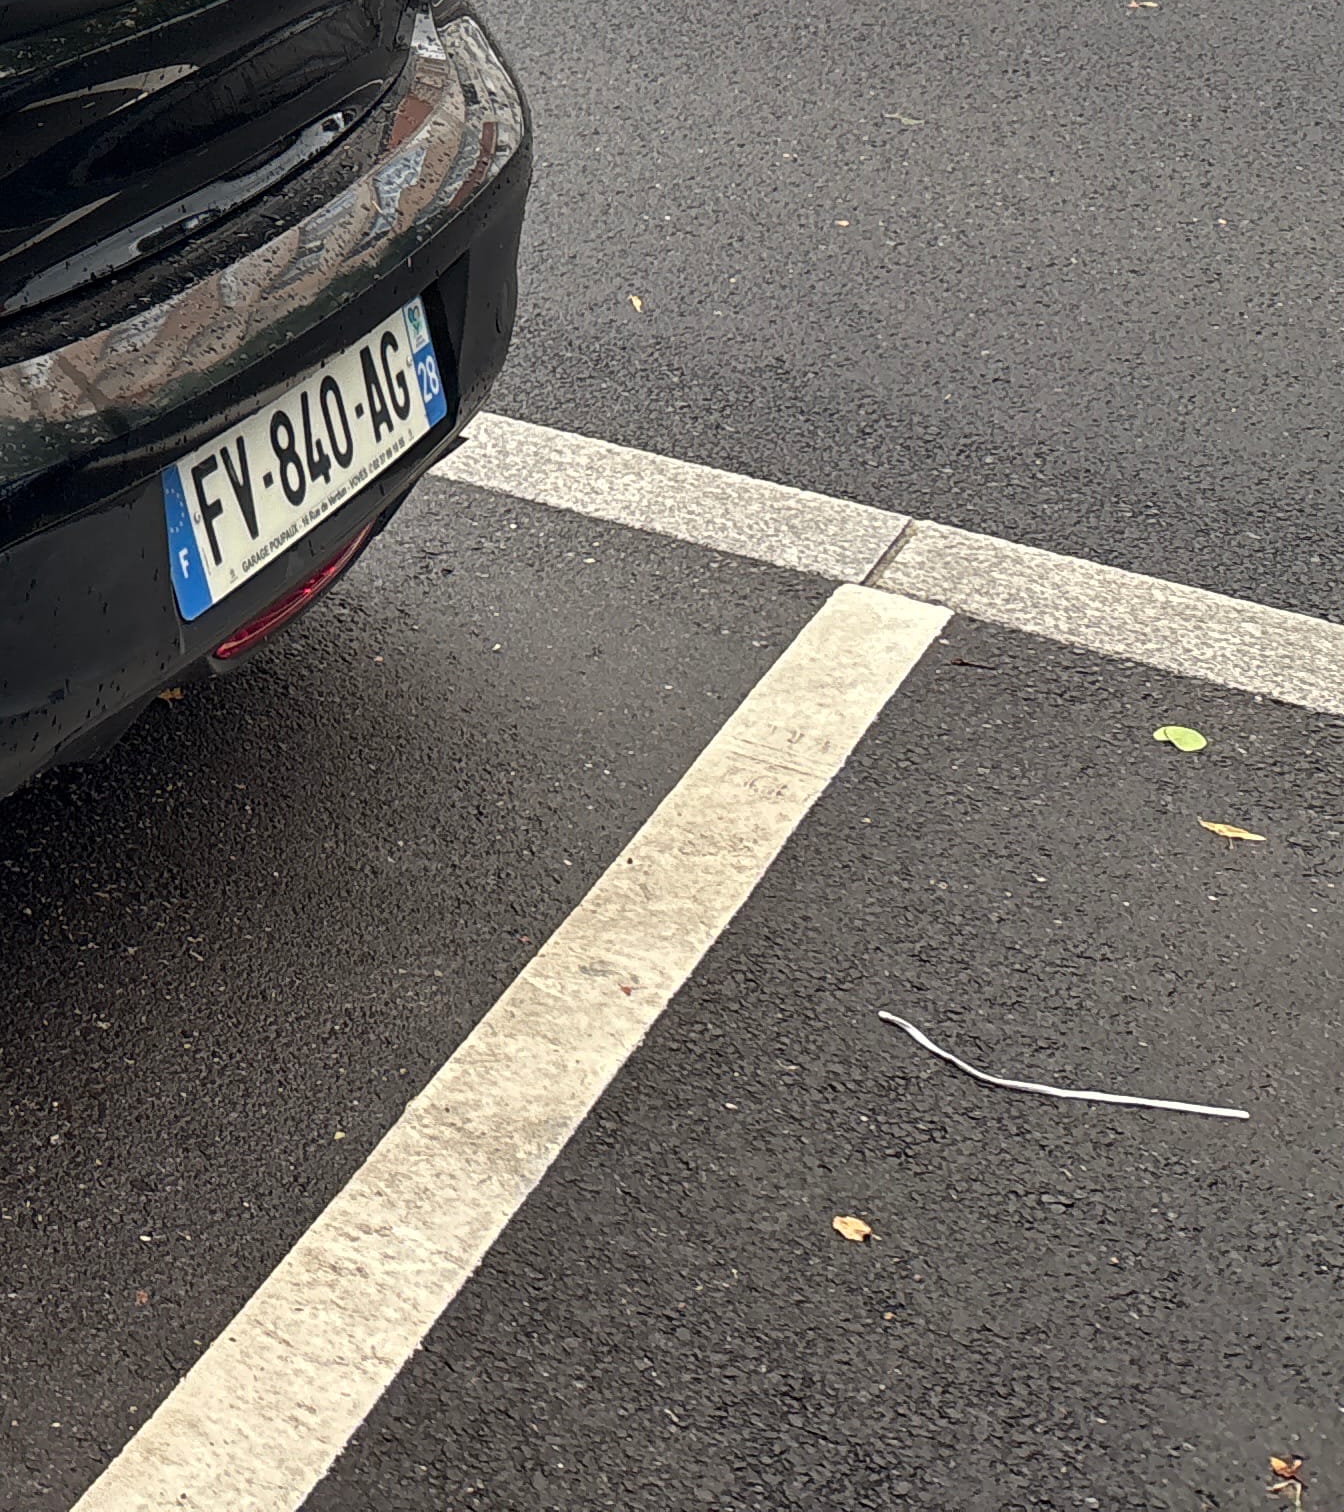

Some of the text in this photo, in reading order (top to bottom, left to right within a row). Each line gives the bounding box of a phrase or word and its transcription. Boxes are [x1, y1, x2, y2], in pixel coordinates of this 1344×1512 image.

[418, 355, 440, 404] 28
[192, 331, 410, 567] FV-840-AG
[178, 548, 190, 579] F
[242, 544, 270, 573] GARAGE
